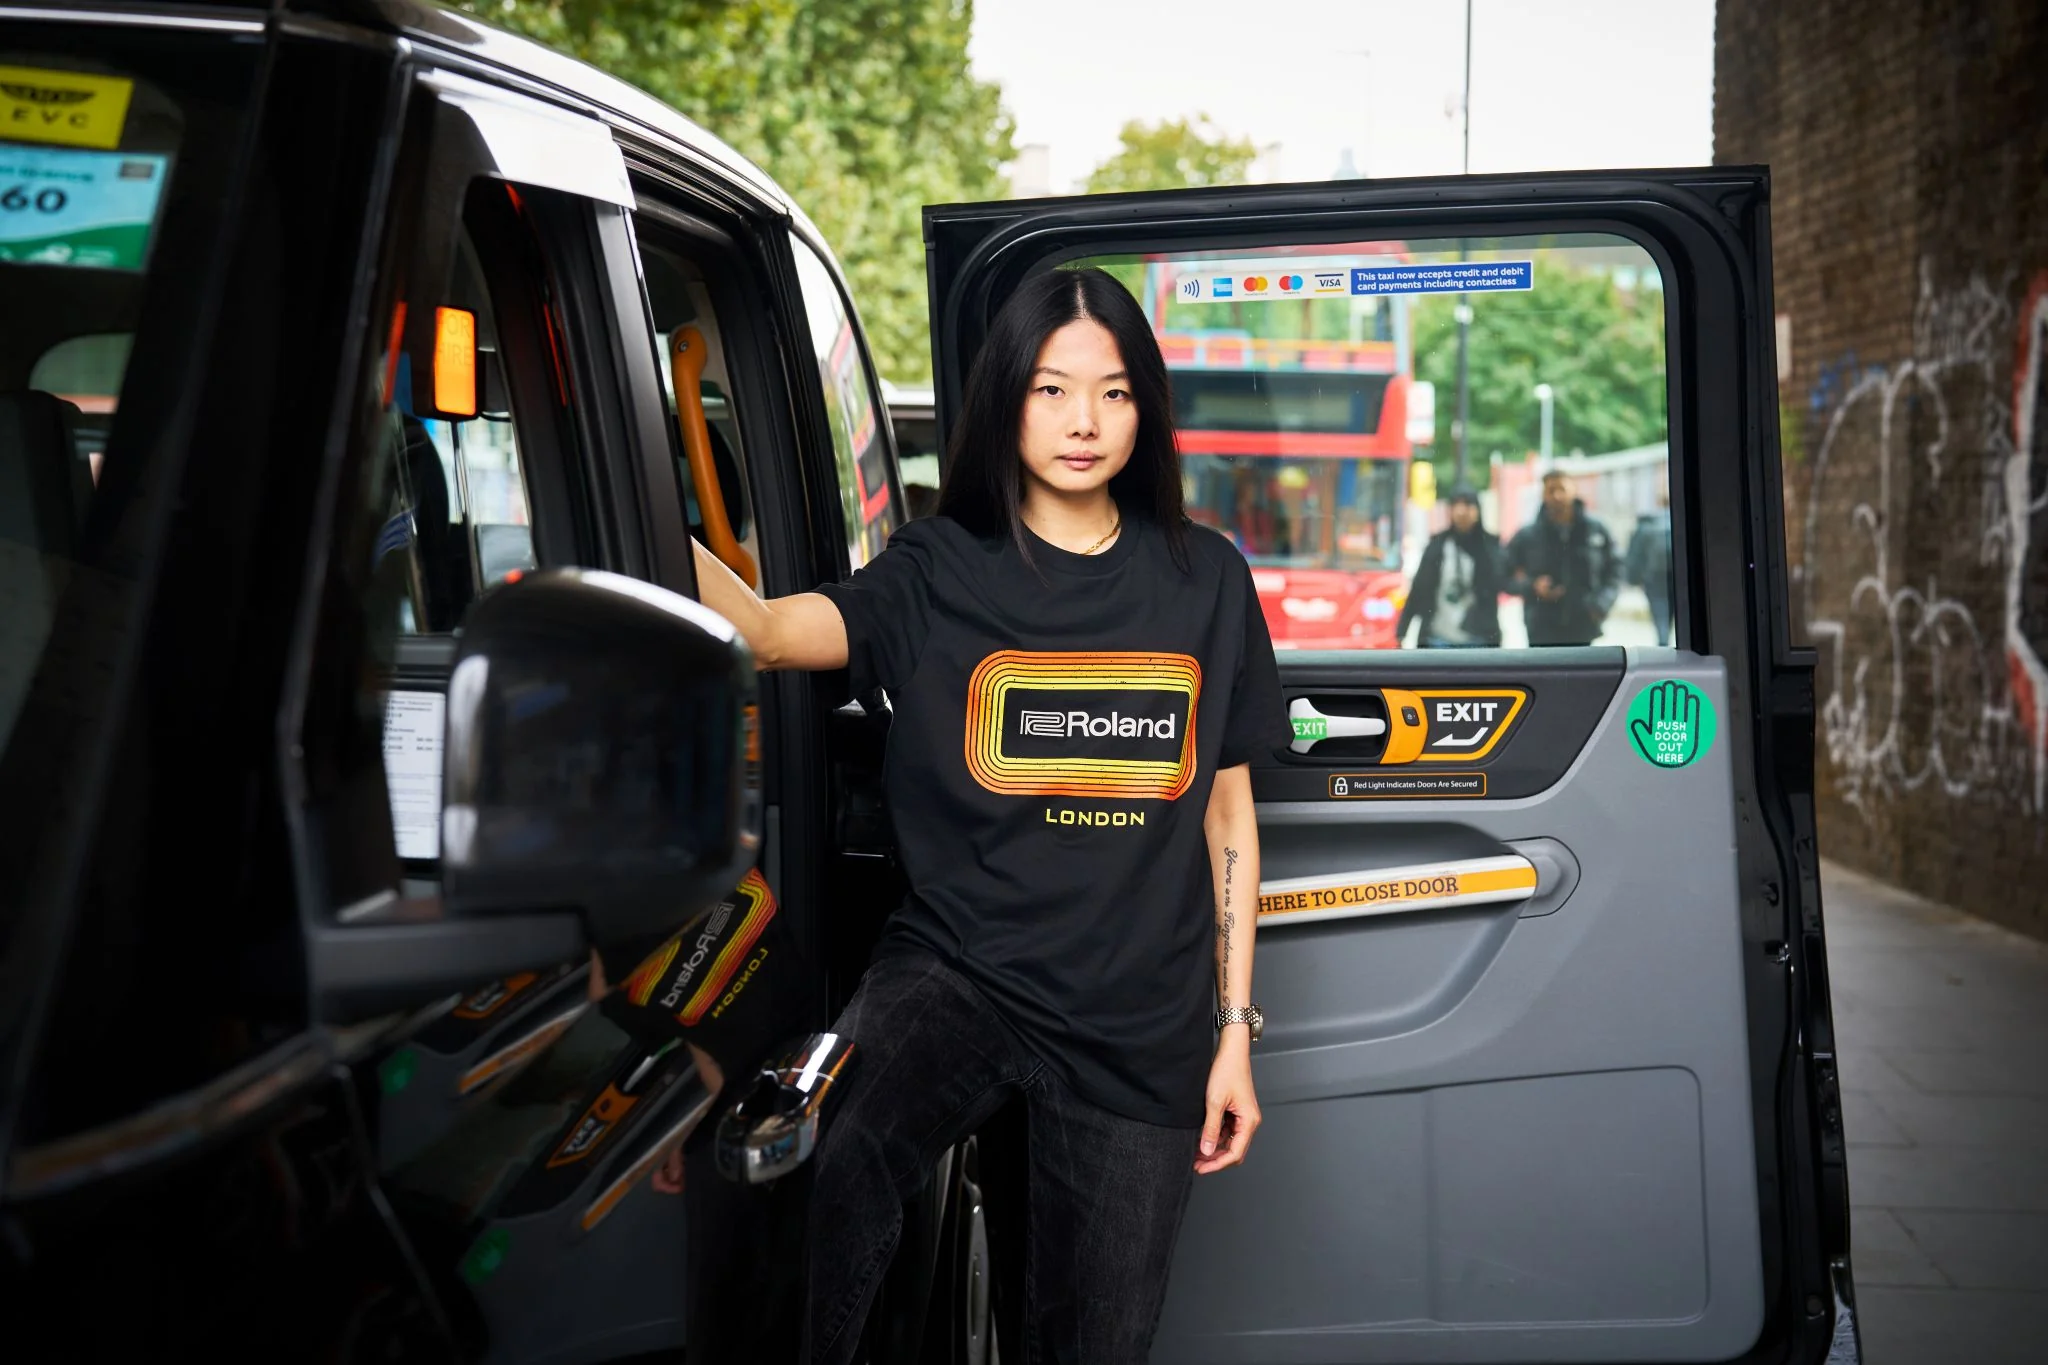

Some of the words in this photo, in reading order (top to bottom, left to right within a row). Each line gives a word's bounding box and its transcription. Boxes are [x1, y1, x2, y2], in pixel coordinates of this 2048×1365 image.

[1357, 272, 1376, 281] This
[1378, 271, 1395, 281] taxi
[1397, 272, 1416, 280] now
[1418, 270, 1452, 280] accepts
[1454, 268, 1480, 278] credit
[1482, 267, 1499, 276] and
[1500, 266, 1525, 276] debit
[1319, 278, 1342, 287] VISA
[1357, 282, 1377, 291] card
[1379, 281, 1422, 292] payments
[1424, 279, 1464, 289] including
[1465, 277, 1517, 287] contactless
[1436, 702, 1498, 722] EXIT
[1066, 711, 1176, 739] Roland
[1293, 722, 1325, 736] EXIT
[1656, 721, 1687, 731] PUSH
[1654, 731, 1687, 742] DOOR
[1658, 742, 1683, 752] OUT
[1656, 753, 1684, 763] HERE
[1354, 781, 1367, 789] Red
[1368, 781, 1385, 790] Light
[1386, 780, 1416, 789] Indicates
[1417, 780, 1437, 788] Doors
[1438, 780, 1449, 788] Are
[1450, 780, 1478, 788] Secured
[1045, 808, 1145, 826] LONDON
[1258, 893, 1308, 912] HERE
[1311, 891, 1337, 907] TO
[1342, 882, 1400, 904] CLOSE
[1404, 876, 1459, 897] DOOR
